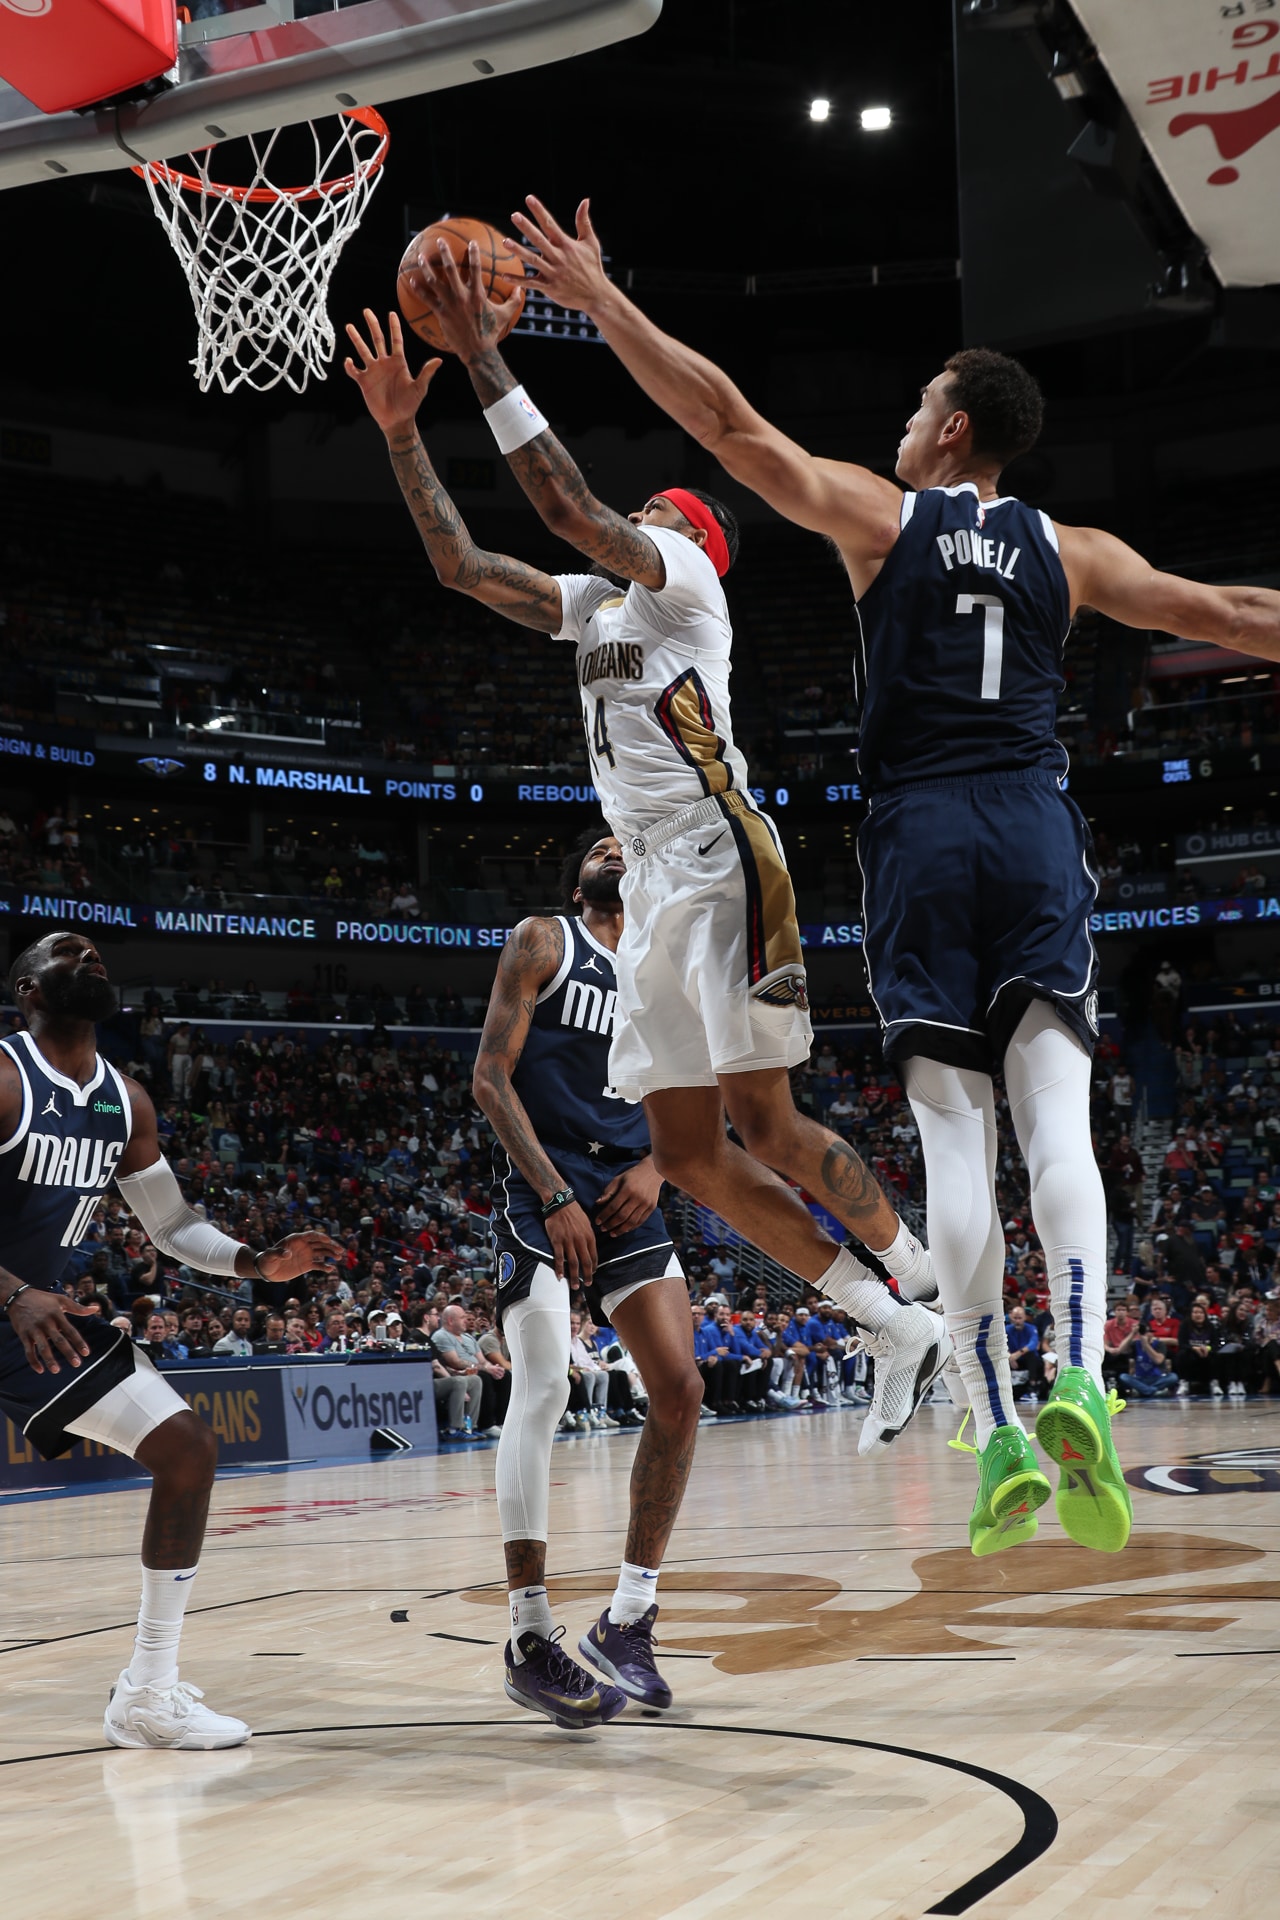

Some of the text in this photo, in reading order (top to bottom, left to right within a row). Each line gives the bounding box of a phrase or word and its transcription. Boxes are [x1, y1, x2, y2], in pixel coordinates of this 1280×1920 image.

[936, 529, 1022, 580] POWELL
[955, 593, 1005, 700] 7
[49, 745, 96, 767] BUILD
[1199, 759, 1213, 777] 6
[203, 763, 218, 782] 8
[228, 765, 251, 784] N.
[256, 767, 371, 795] MARSHALL
[385, 779, 457, 801] POINTS
[470, 784, 484, 802] 0
[775, 786, 790, 806] 0
[825, 783, 863, 802] STE
[1252, 829, 1280, 845] CL
[21, 894, 137, 927] JANITORIAL
[154, 910, 316, 938] MAINTENANCE
[1089, 905, 1201, 932] SERVICES
[336, 921, 472, 946] PRODUCTION
[821, 924, 864, 945] ASS
[93, 1100, 122, 1114] chime
[59, 1195, 103, 1247] 10
[311, 1382, 423, 1431] Ochsner
